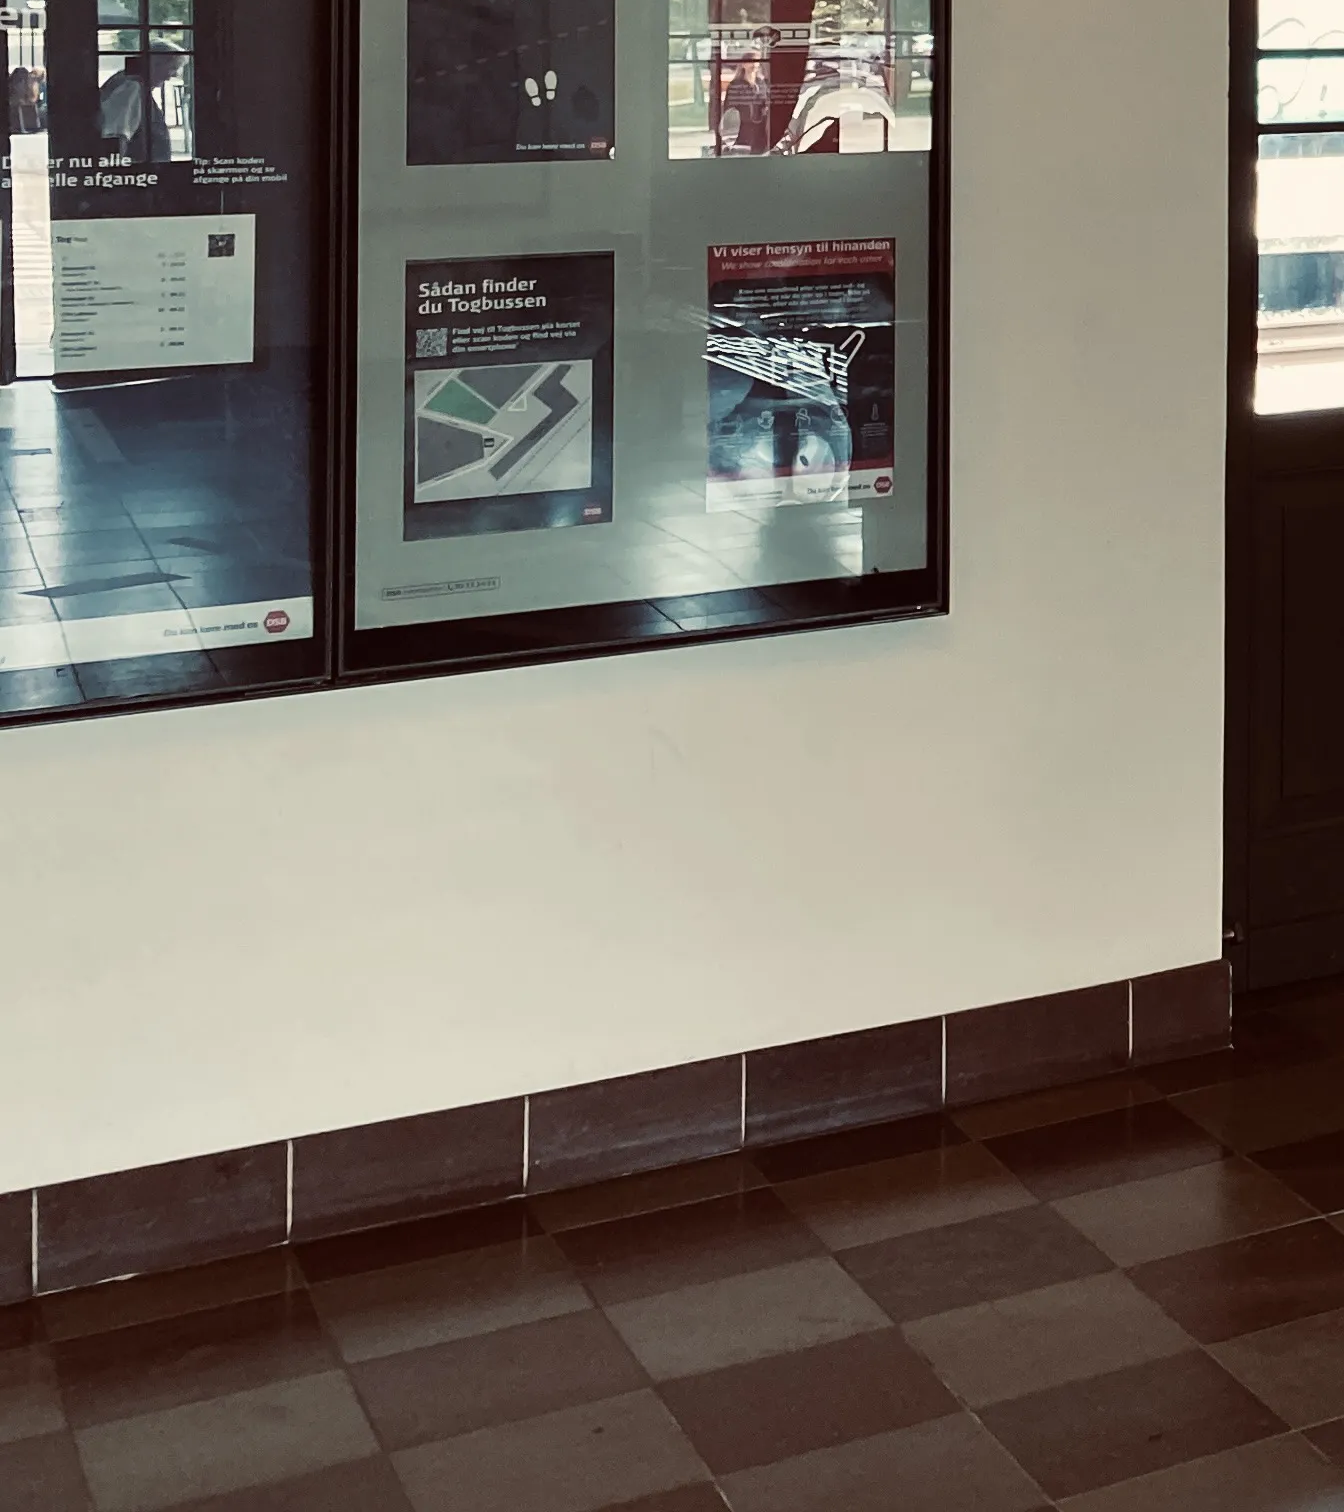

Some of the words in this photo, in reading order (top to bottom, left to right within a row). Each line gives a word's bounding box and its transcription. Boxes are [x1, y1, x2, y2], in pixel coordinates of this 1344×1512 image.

[69, 157, 93, 168] nu
[98, 154, 132, 168] alle
[83, 172, 158, 188] afgange
[713, 246, 727, 258] Vi
[731, 245, 761, 257] viser
[765, 244, 812, 257] hensyn
[816, 242, 829, 253] til
[832, 240, 890, 253] hinanden
[418, 282, 476, 298] Sådan
[482, 277, 537, 293] finder
[418, 301, 442, 315] du
[448, 296, 547, 314] Togbussen
